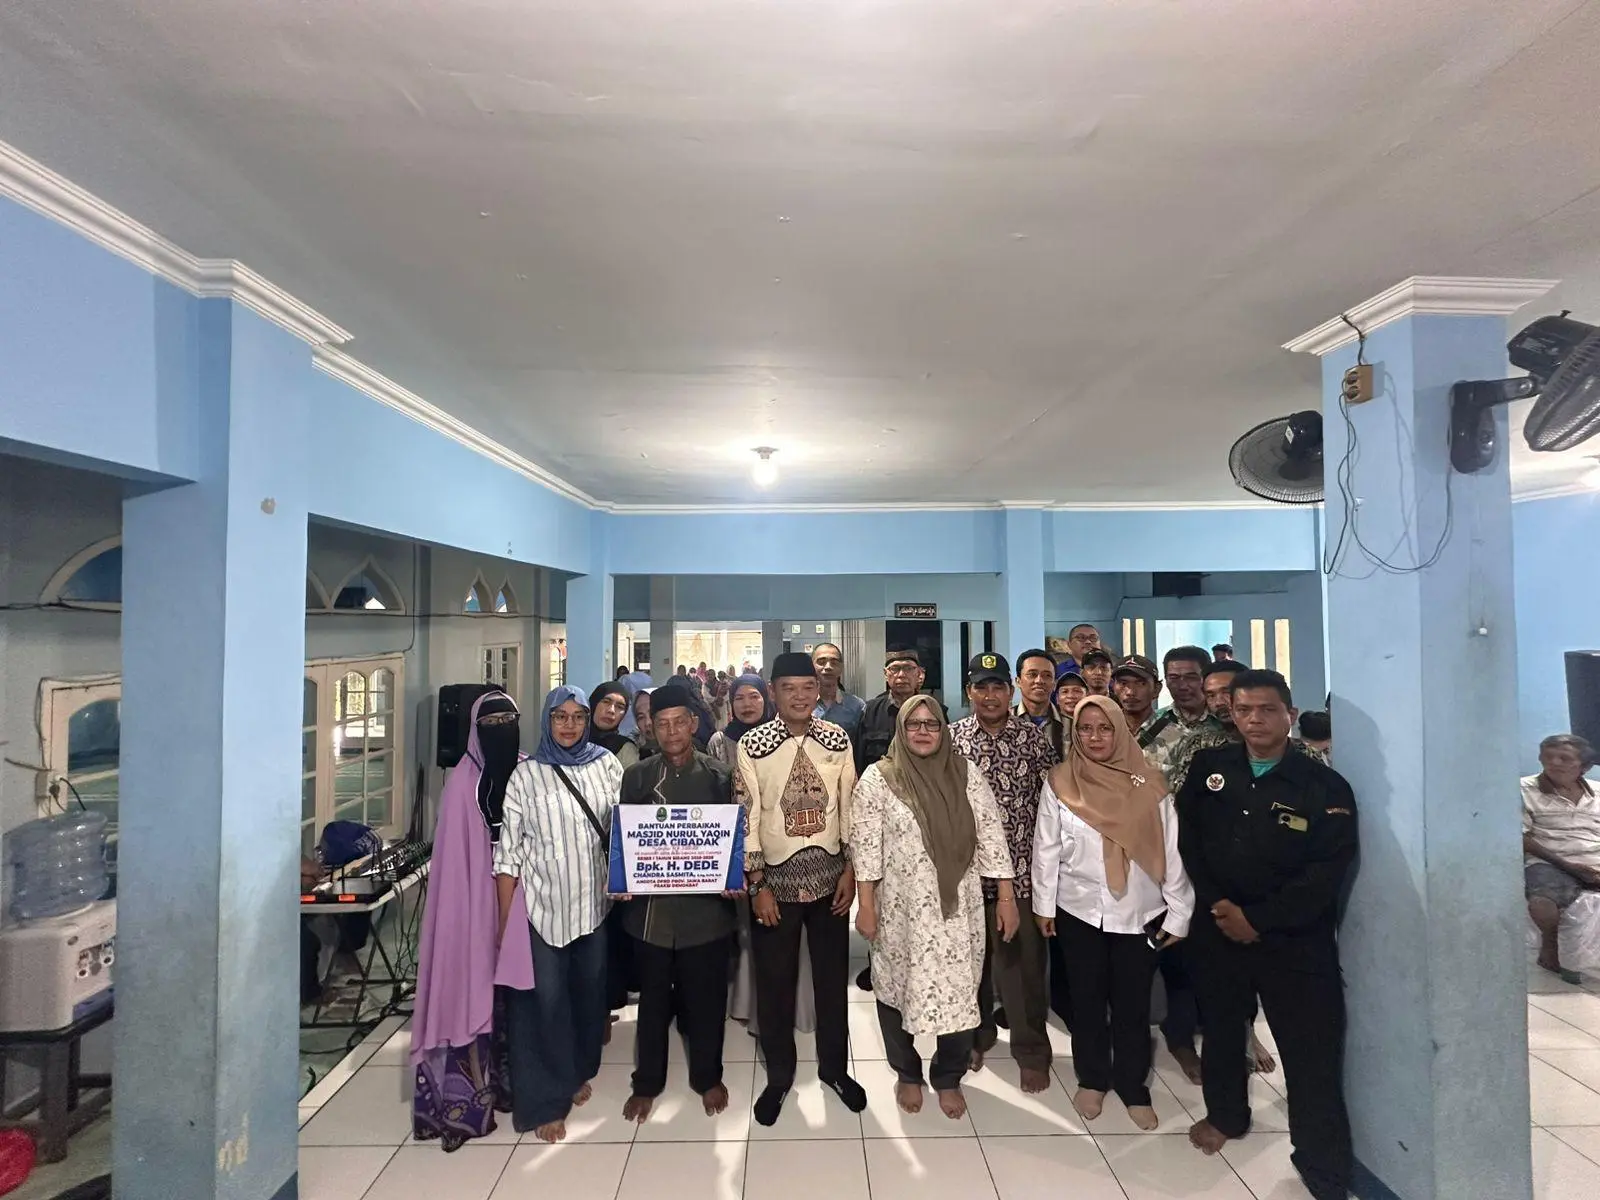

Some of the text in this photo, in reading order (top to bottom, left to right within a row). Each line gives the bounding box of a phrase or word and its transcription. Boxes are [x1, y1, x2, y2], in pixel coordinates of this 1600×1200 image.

[627, 829, 730, 839] MASJID NURUL YAQIN
[638, 838, 719, 846] DESA CIBADAK
[636, 860, 719, 872] Bpk. H. DEDE
